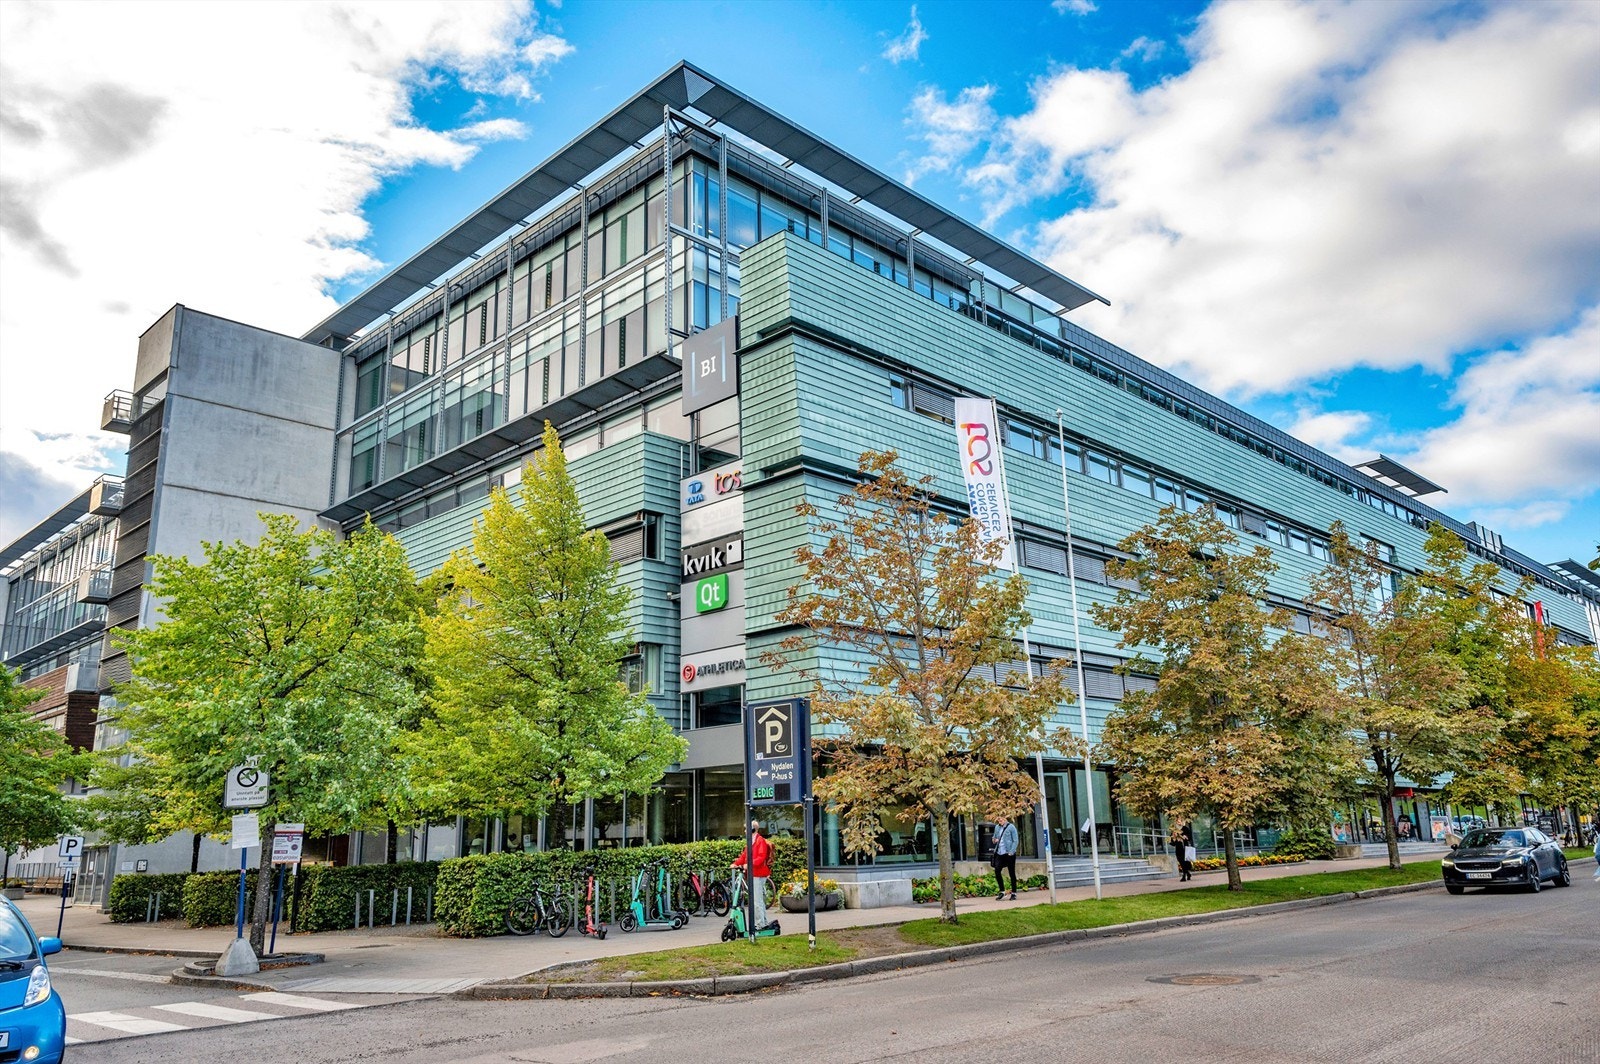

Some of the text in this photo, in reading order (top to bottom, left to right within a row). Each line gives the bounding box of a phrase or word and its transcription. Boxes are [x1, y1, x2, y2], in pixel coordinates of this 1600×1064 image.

[701, 355, 717, 378] BI
[685, 494, 704, 505] TATA
[701, 581, 720, 607] Qt
[697, 658, 746, 677] ATHLETICA
[765, 720, 783, 754] P
[771, 762, 793, 772] Nydalen
[771, 771, 793, 781] P-hus S
[65, 839, 78, 853] P
